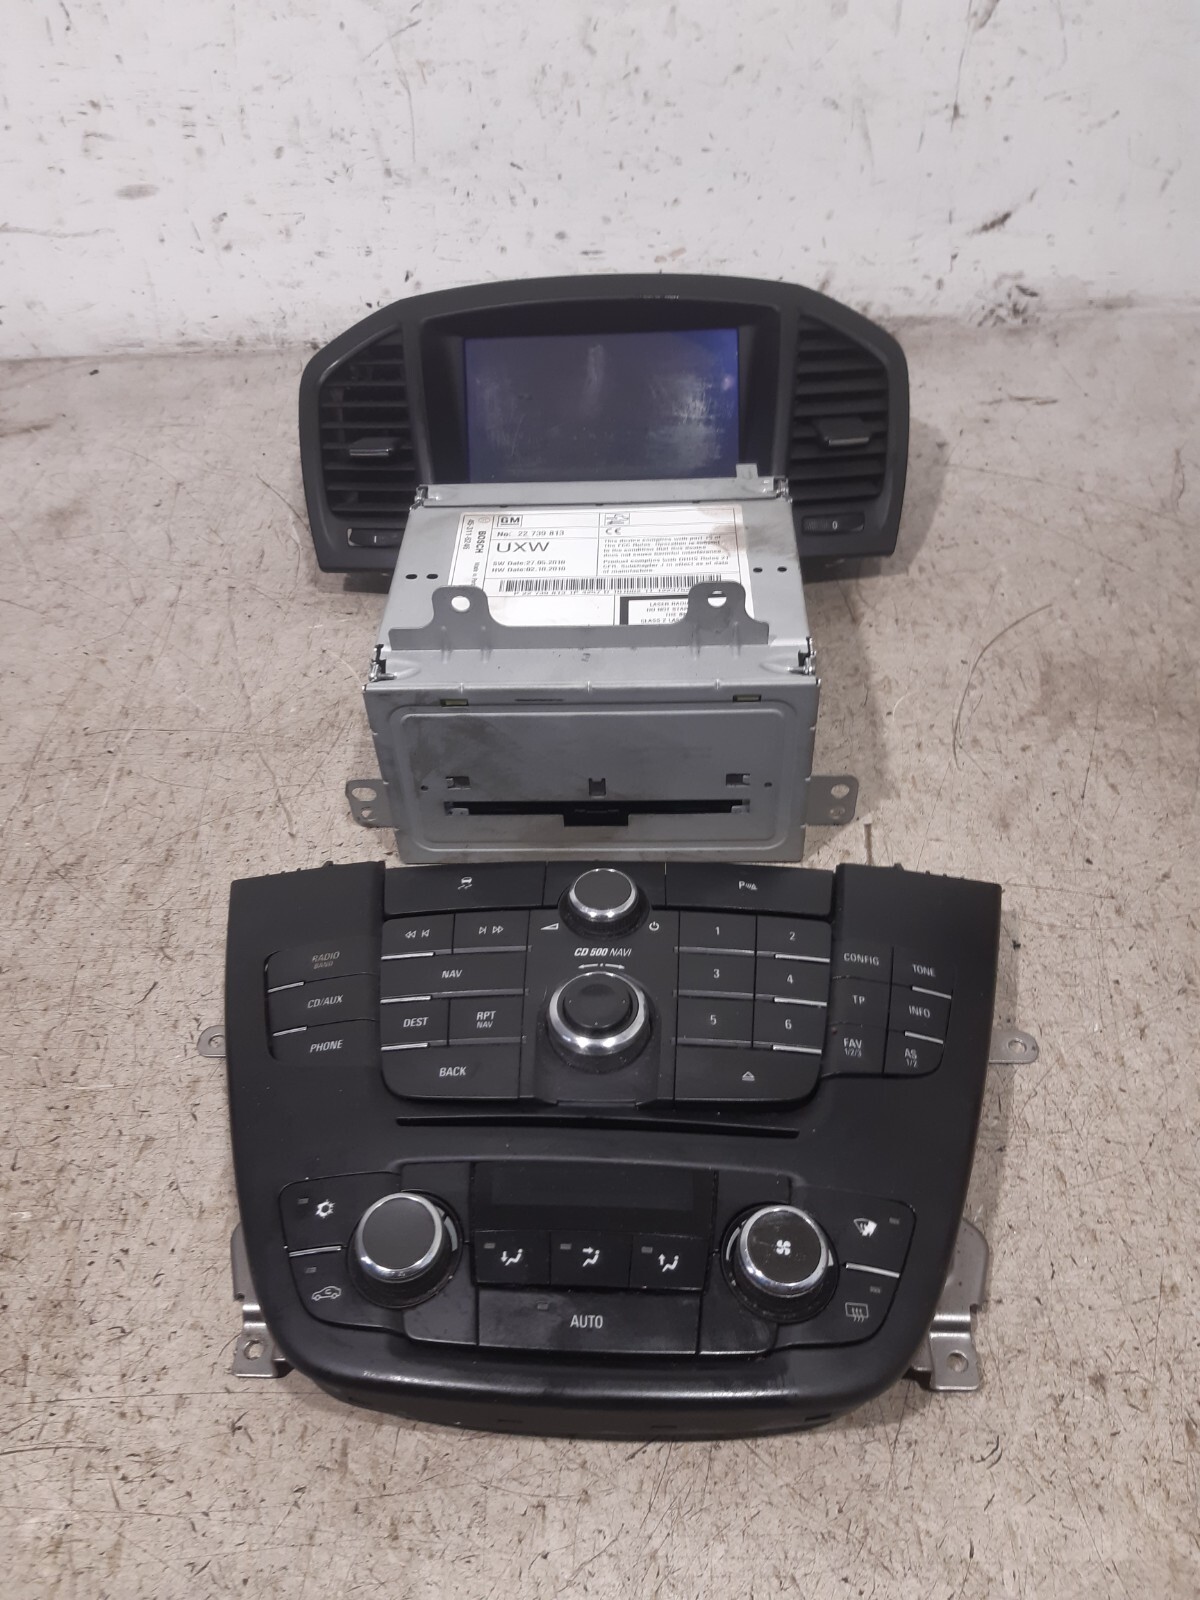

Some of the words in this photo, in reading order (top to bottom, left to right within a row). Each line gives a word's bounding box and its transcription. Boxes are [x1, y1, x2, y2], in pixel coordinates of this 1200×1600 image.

[500, 516, 520, 524] GM
[474, 530, 486, 554] BOSCH
[496, 541, 550, 553] UXW
[714, 926, 720, 935] 1
[789, 932, 796, 941] 2
[311, 951, 340, 963] RADIO
[574, 948, 589, 957] CD
[590, 947, 609, 957] 500
[609, 948, 632, 957] NAVI
[843, 952, 880, 966] CONFIG
[441, 969, 463, 979] NAV
[713, 969, 720, 978] 3
[912, 964, 936, 977] TONE
[786, 974, 794, 984] 4
[307, 994, 344, 1009] CD/AUX
[852, 994, 865, 1005] TP
[476, 1011, 496, 1021] RPT
[908, 1005, 931, 1018] INFO
[403, 1016, 429, 1027] DEST
[476, 1021, 493, 1029] NAV
[710, 1015, 717, 1025] 5
[785, 1019, 792, 1029] 6
[309, 1039, 344, 1053] PHONE
[843, 1037, 862, 1049] FAV
[904, 1047, 918, 1060] AS
[439, 1066, 467, 1077] BACK
[570, 1314, 604, 1329] AUTO
